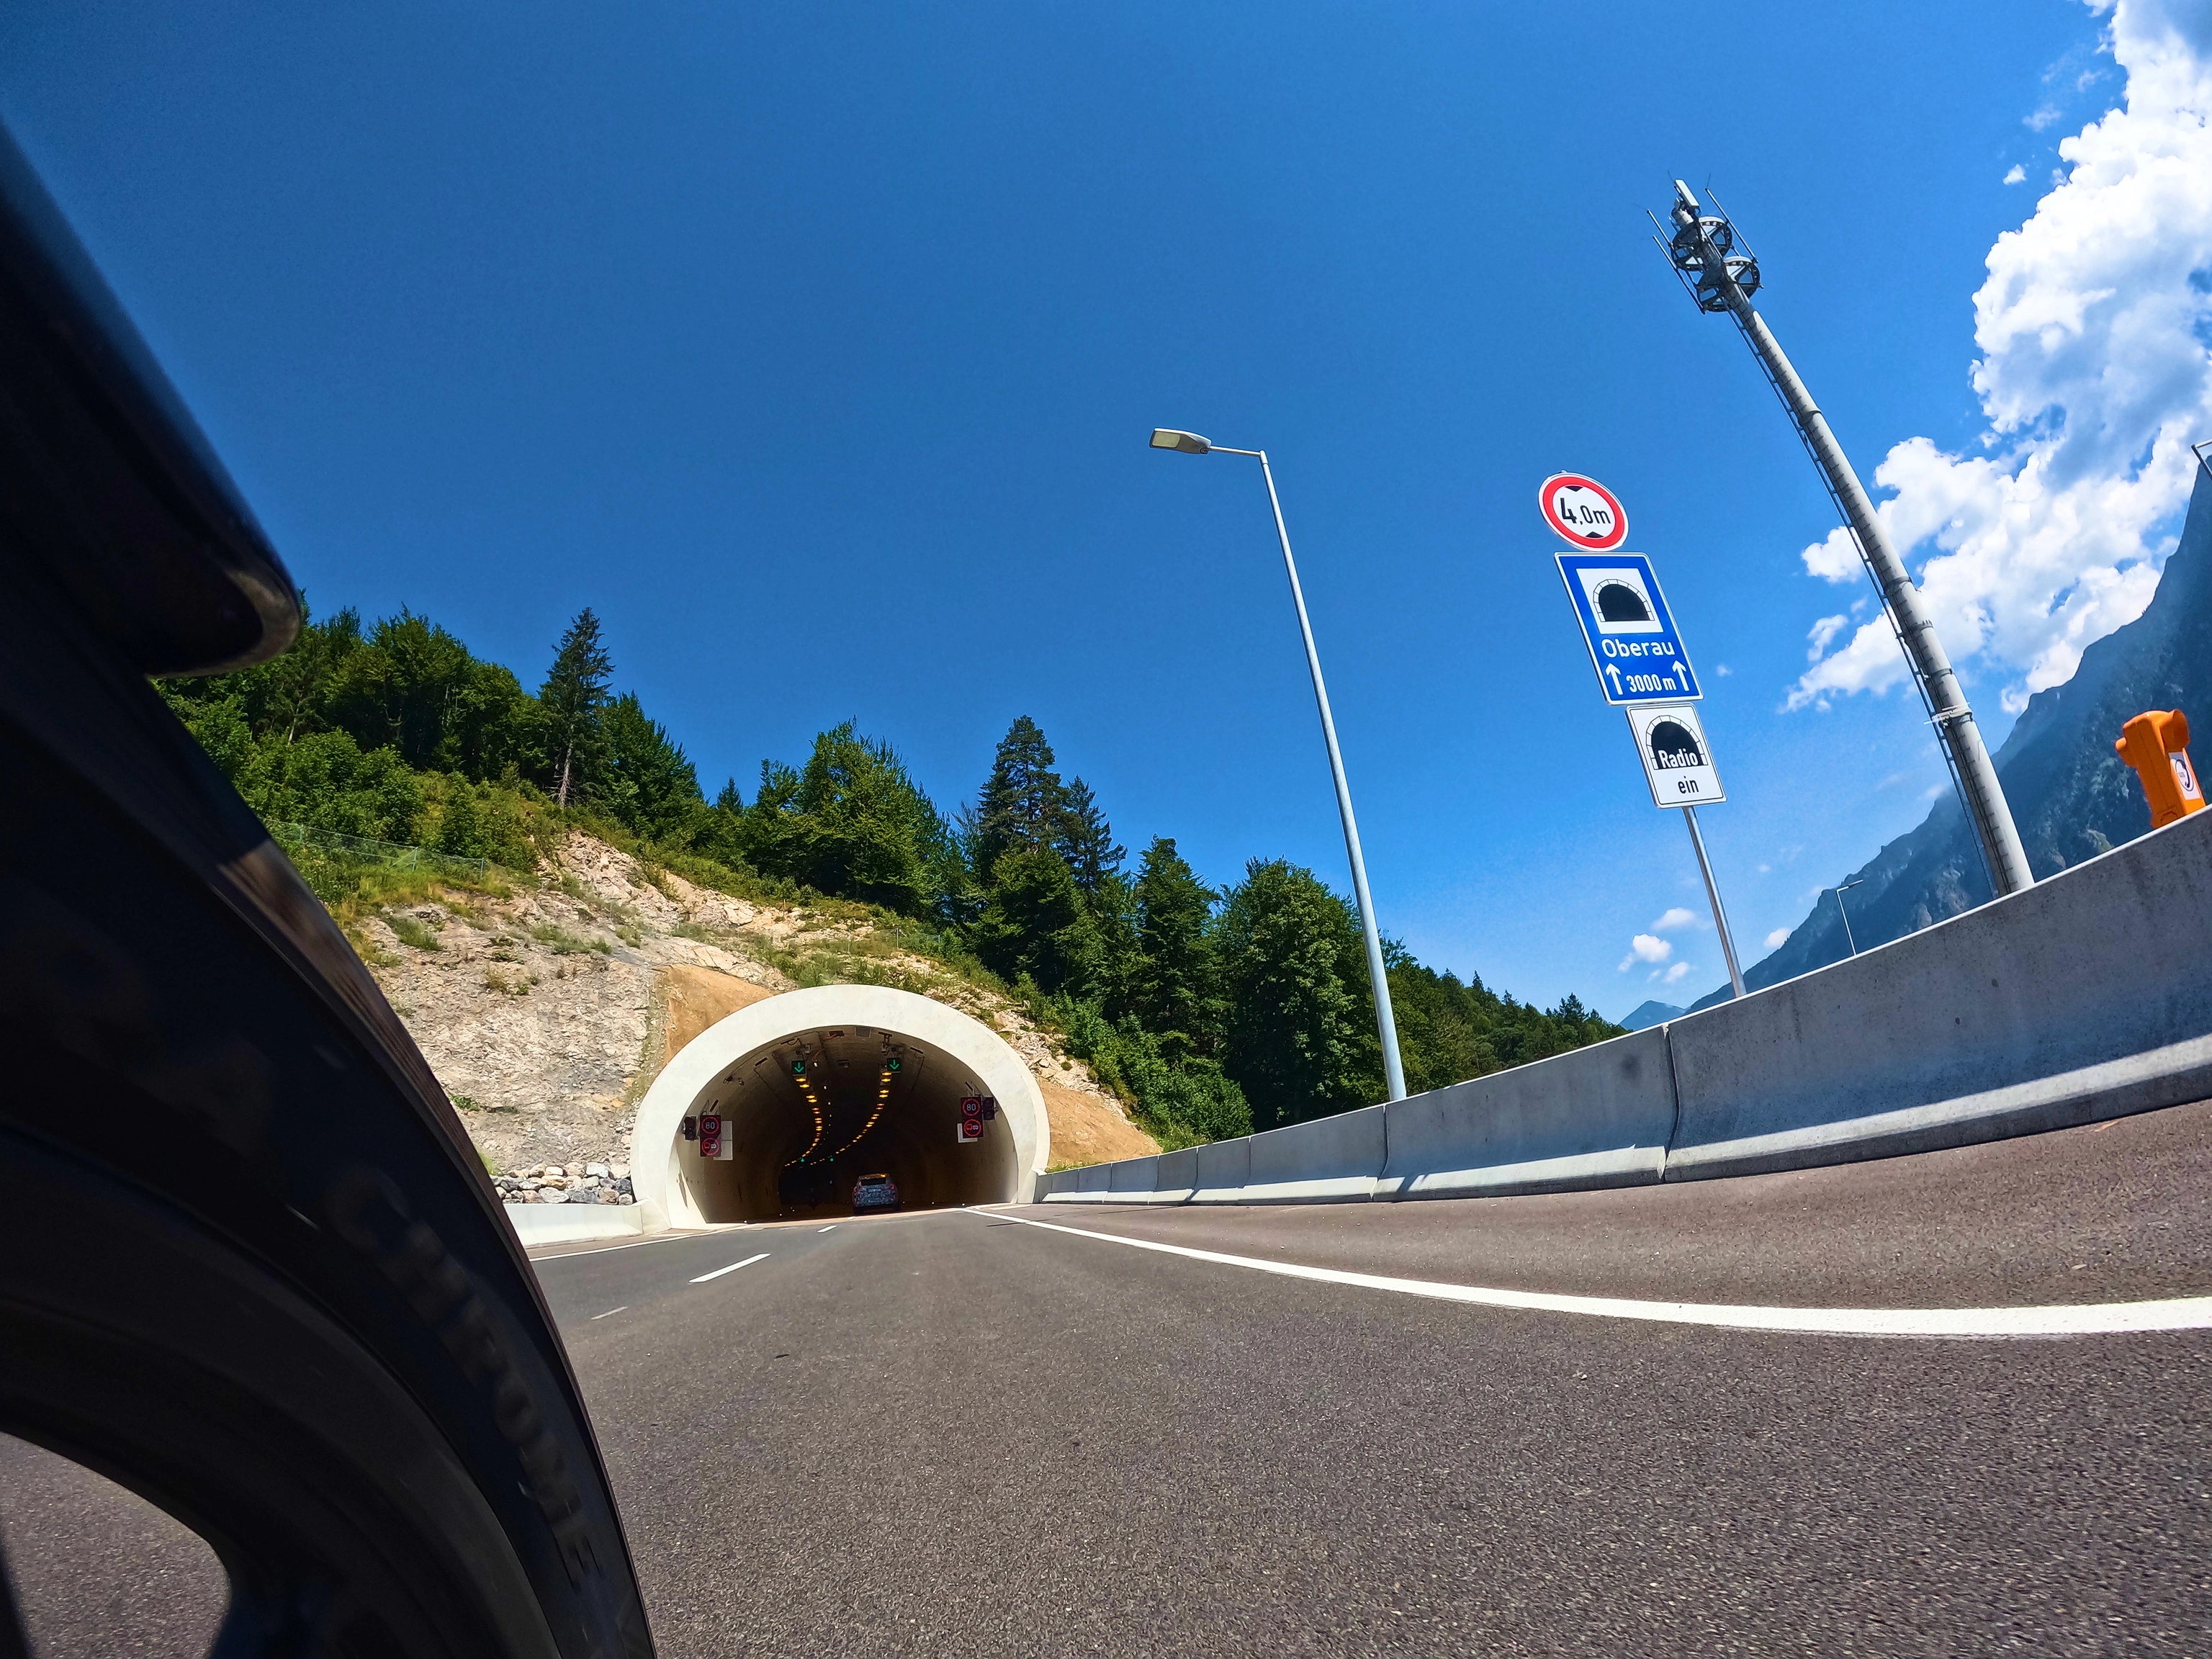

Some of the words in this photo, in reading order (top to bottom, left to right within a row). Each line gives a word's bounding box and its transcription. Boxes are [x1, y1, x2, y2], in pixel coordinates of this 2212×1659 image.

[1560, 497, 1611, 526] 4,0m
[1601, 638, 1676, 658] Oberau
[1625, 673, 1663, 693] 3000
[1663, 675, 1677, 691] m
[1658, 747, 1699, 768] Radio
[1678, 775, 1699, 794] ein
[705, 1121, 715, 1130] 80
